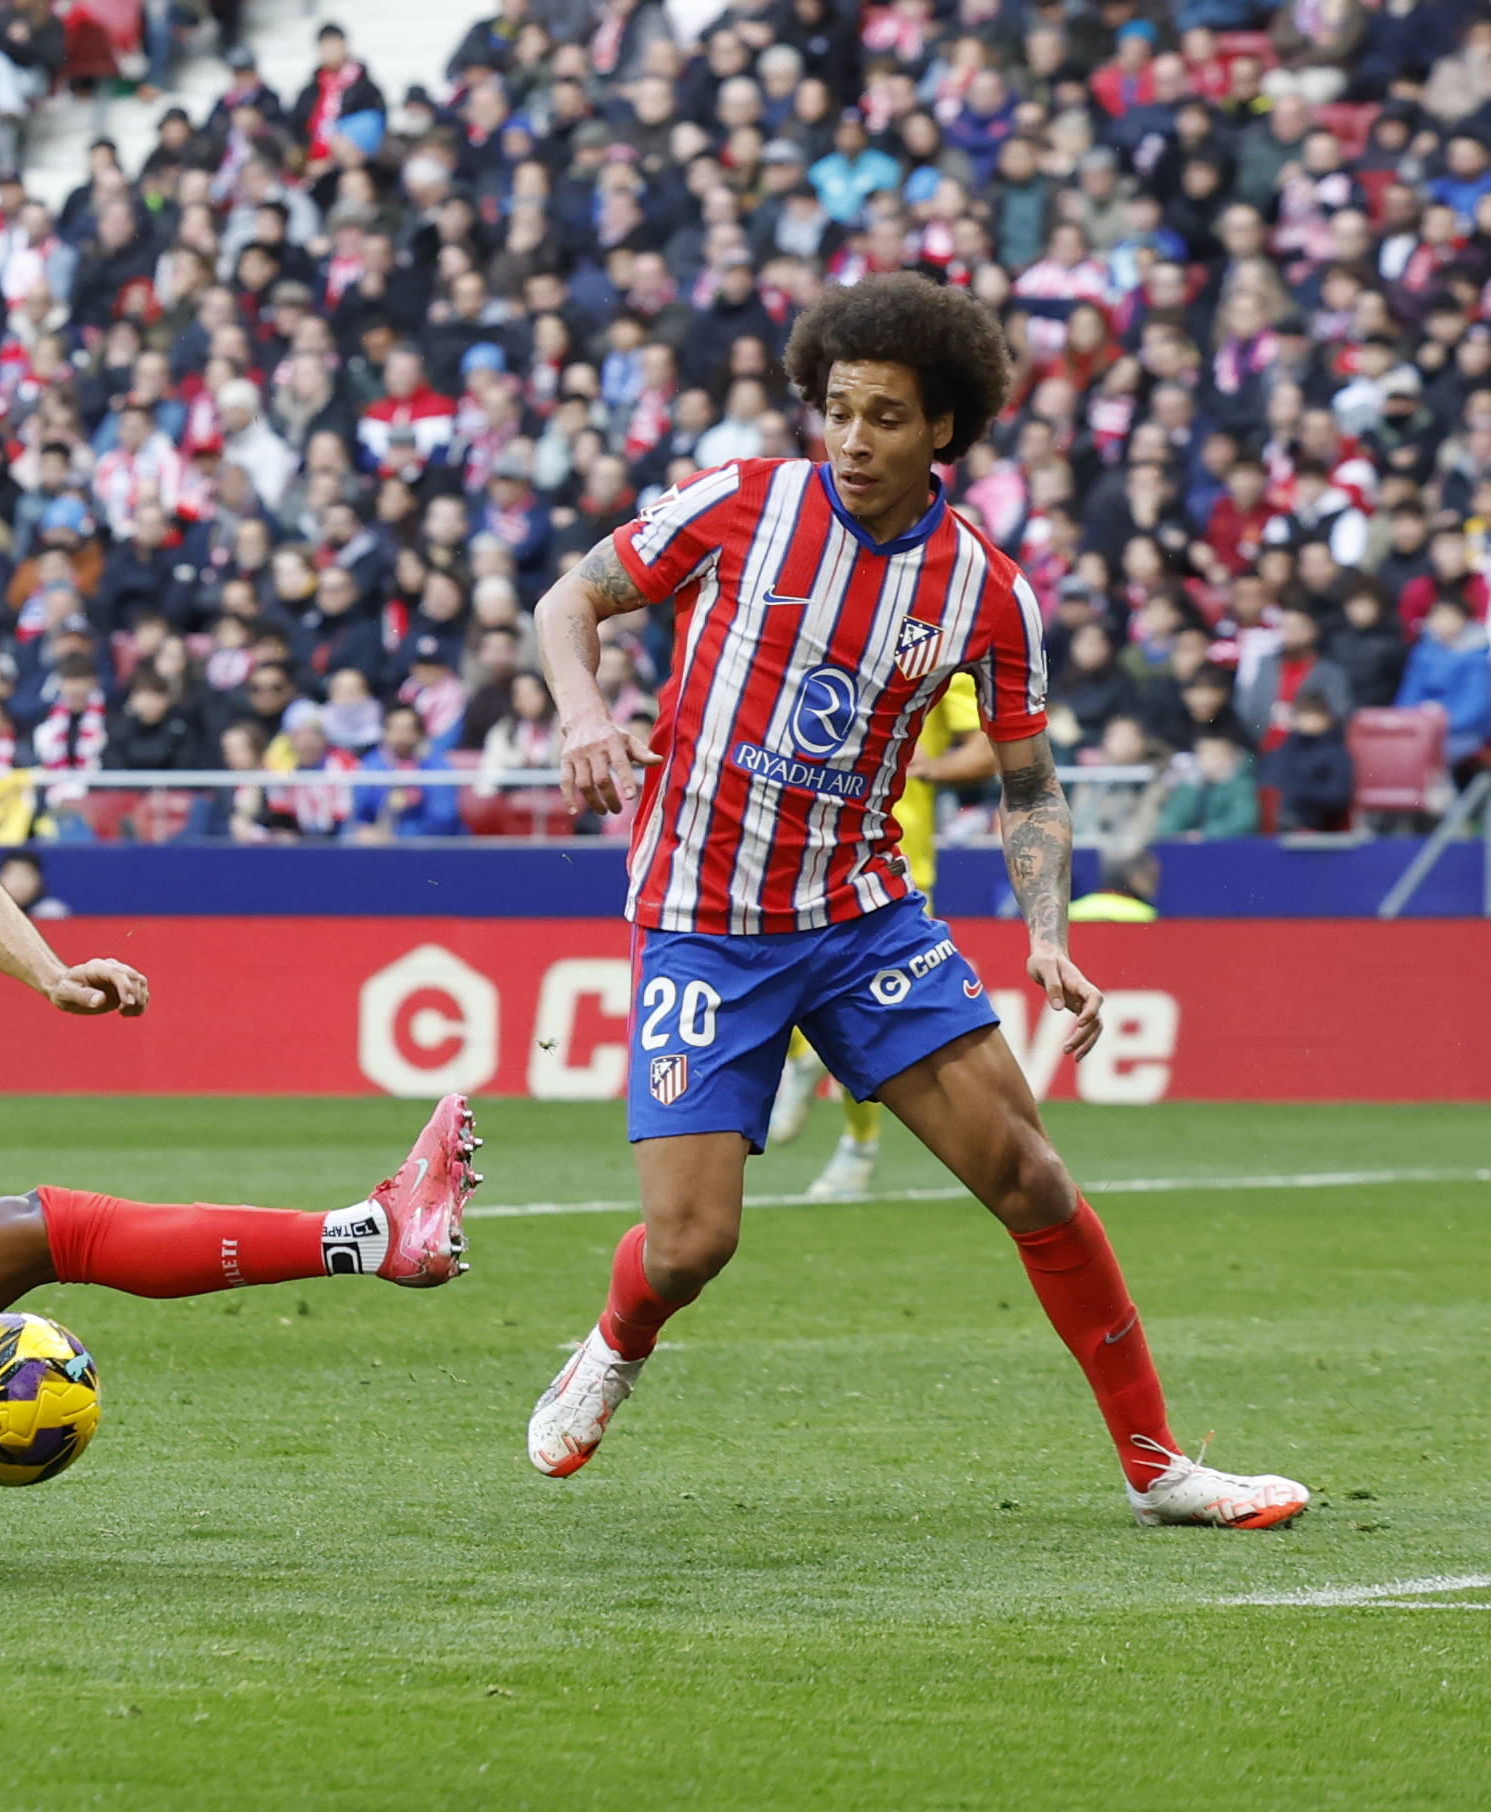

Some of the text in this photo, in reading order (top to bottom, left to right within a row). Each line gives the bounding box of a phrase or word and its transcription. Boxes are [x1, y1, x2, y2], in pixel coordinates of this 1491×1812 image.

[737, 744, 864, 796] RIYADH AIR
[641, 976, 722, 1051] 20
[322, 1225, 351, 1237] TAPE
